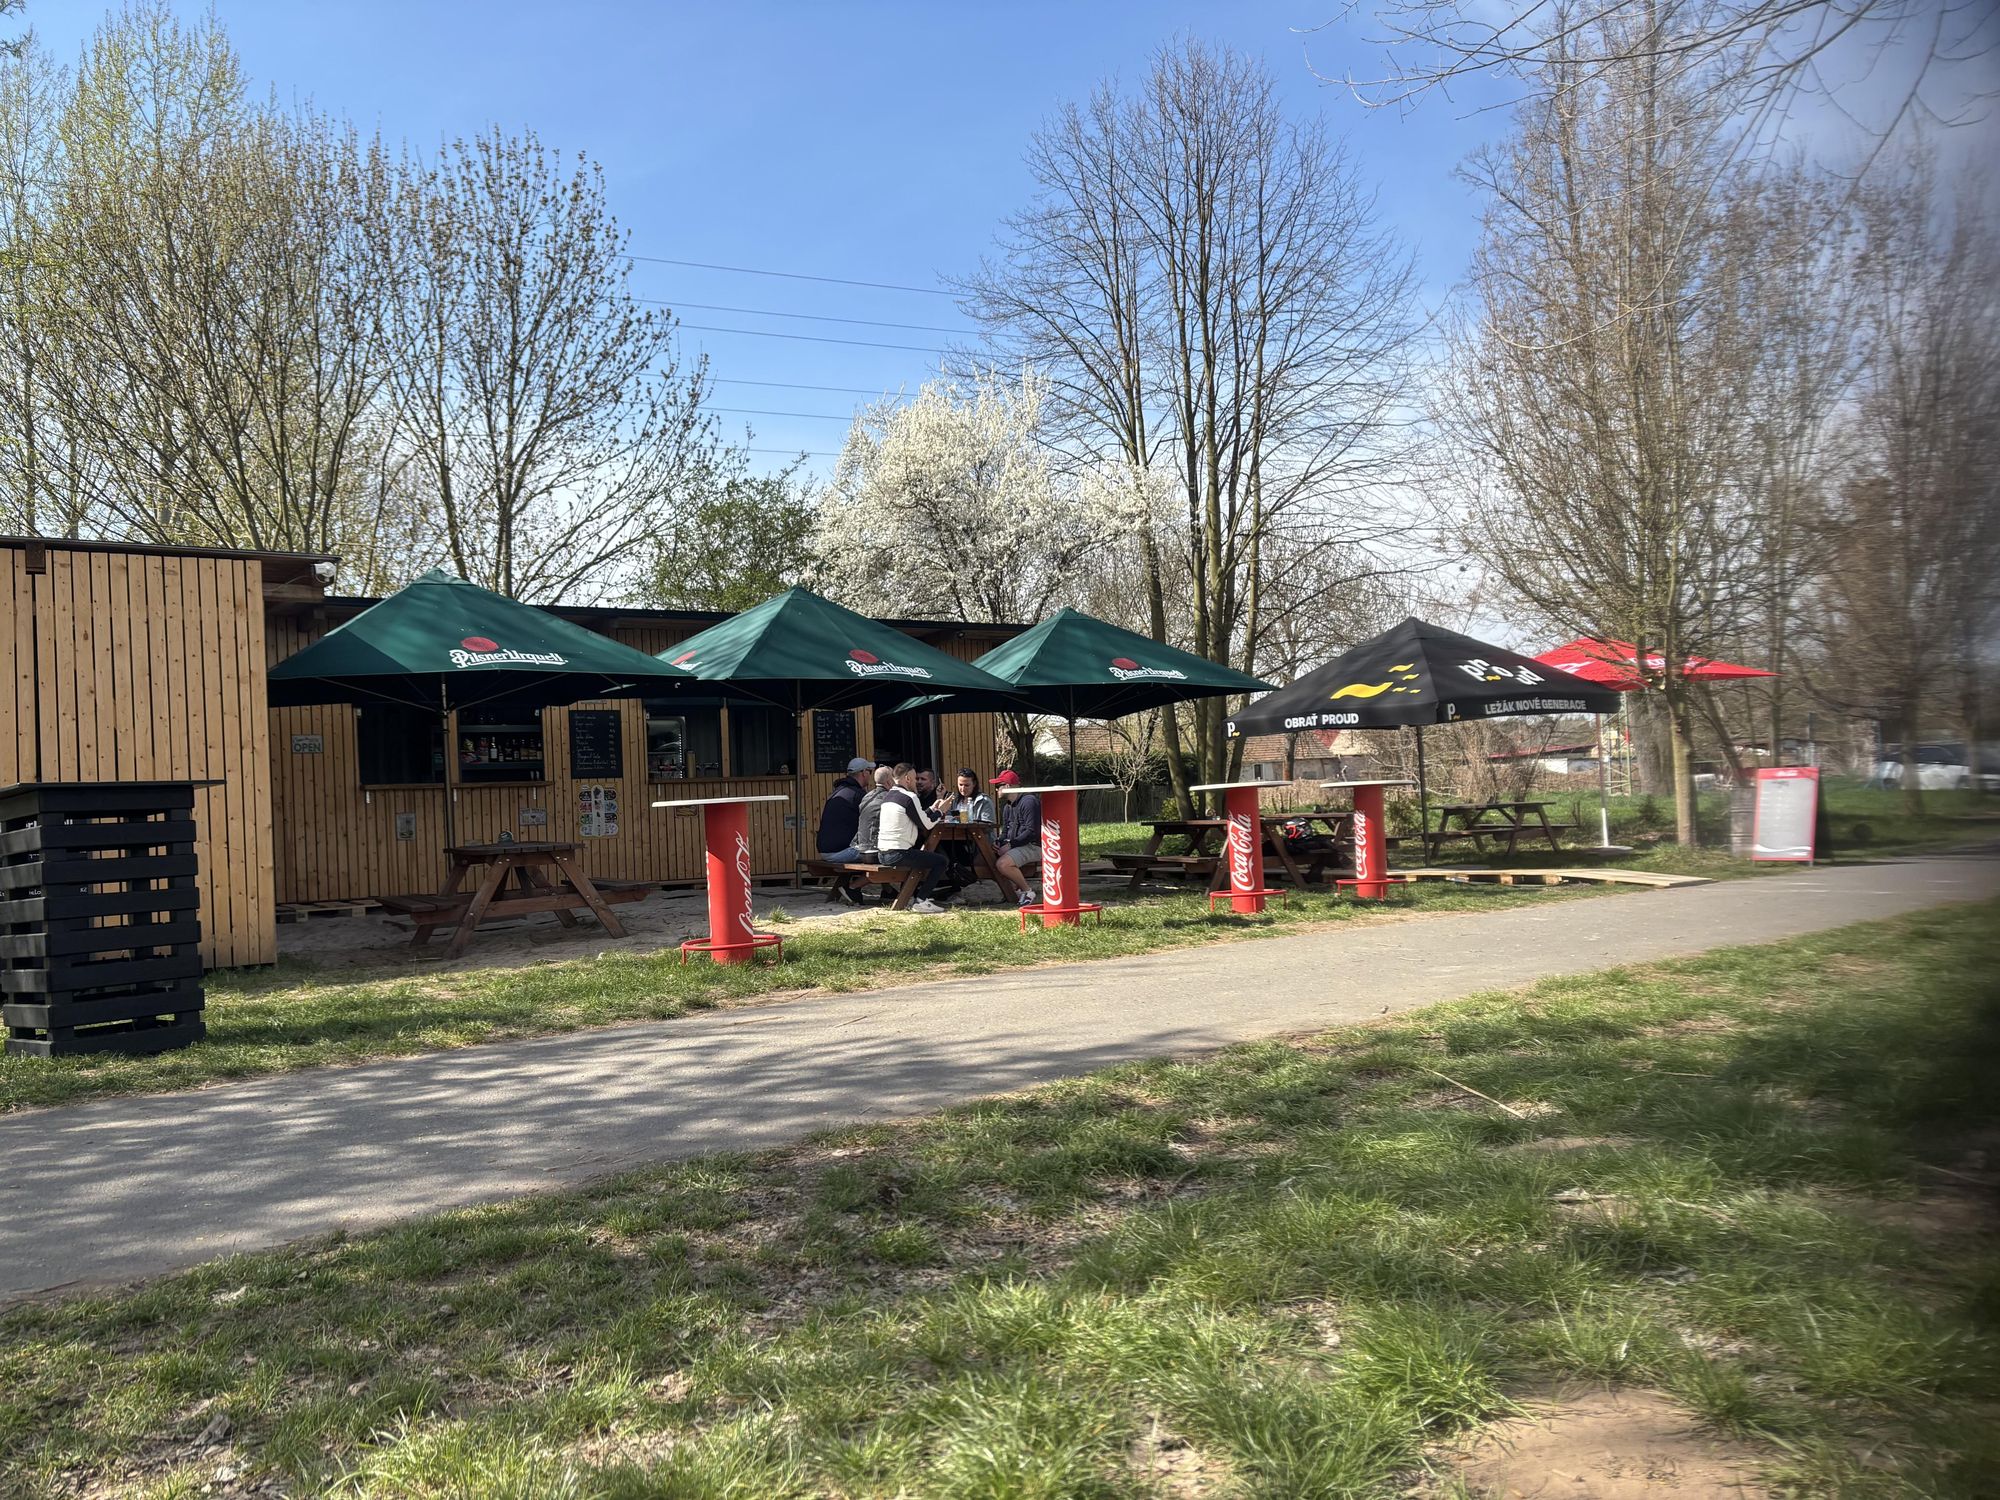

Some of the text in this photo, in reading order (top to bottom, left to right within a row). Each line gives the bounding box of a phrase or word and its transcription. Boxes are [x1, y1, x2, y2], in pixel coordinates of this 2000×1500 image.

[448, 648, 569, 668] Pilsner Urquell
[845, 660, 889, 677] Pilsner
[1485, 697, 1587, 714] LEŽÁK NOVÉ GENERACE
[1284, 713, 1360, 729] OBRAŤ PROUD
[293, 743, 321, 752] OPEN
